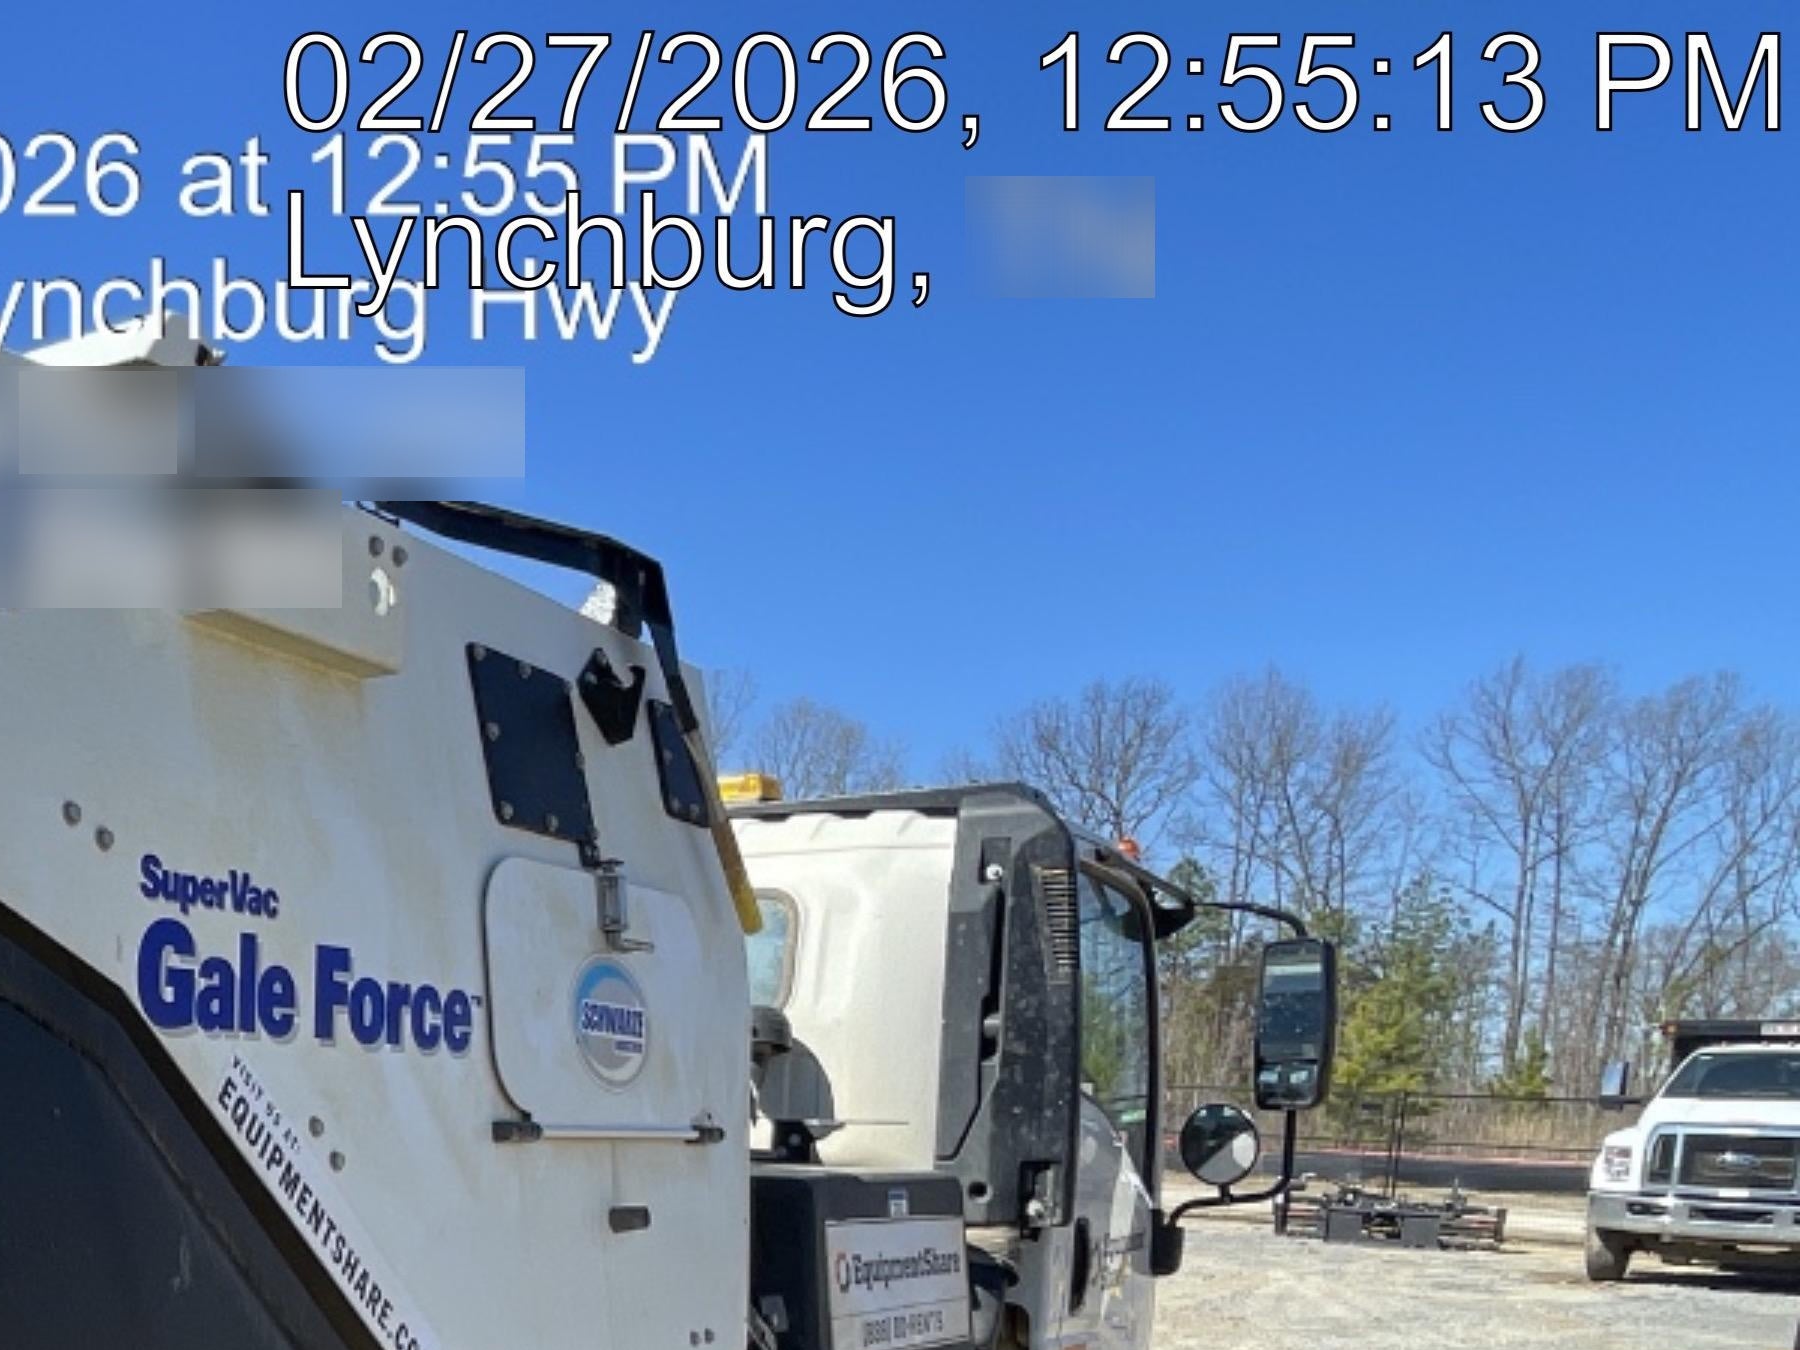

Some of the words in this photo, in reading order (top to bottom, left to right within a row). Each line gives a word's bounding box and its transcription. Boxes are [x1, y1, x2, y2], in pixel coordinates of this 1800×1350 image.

[140, 854, 278, 919] SuperVac
[137, 917, 296, 1038] Gale
[852, 1248, 960, 1290] EquipmentShare
